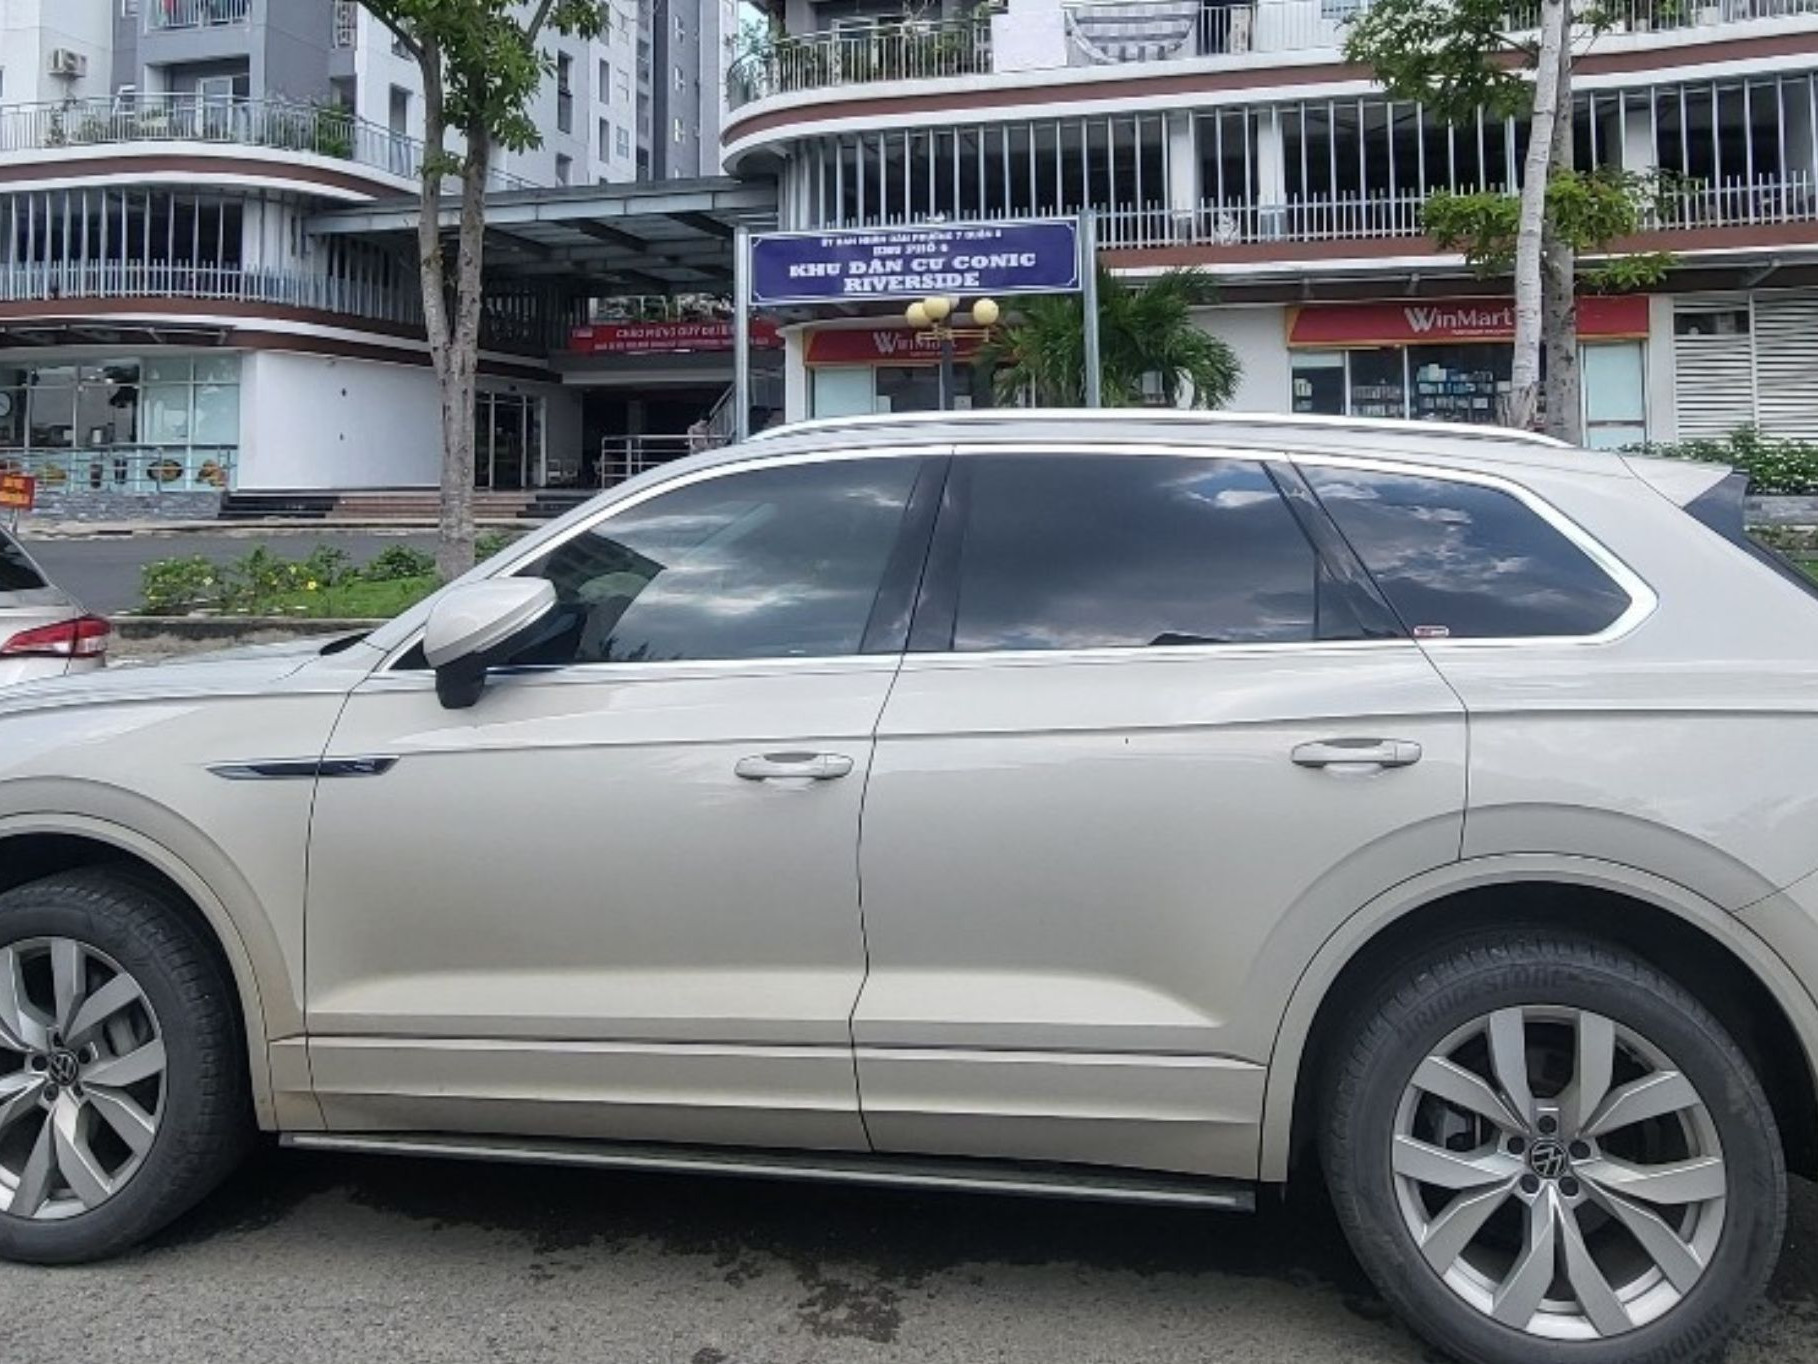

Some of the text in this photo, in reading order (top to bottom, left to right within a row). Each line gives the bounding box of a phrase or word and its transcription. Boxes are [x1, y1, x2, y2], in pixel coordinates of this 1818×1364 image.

[789, 262, 841, 278] KHU
[952, 252, 1037, 270] CONIC
[843, 271, 980, 292] RIVERSIDE
